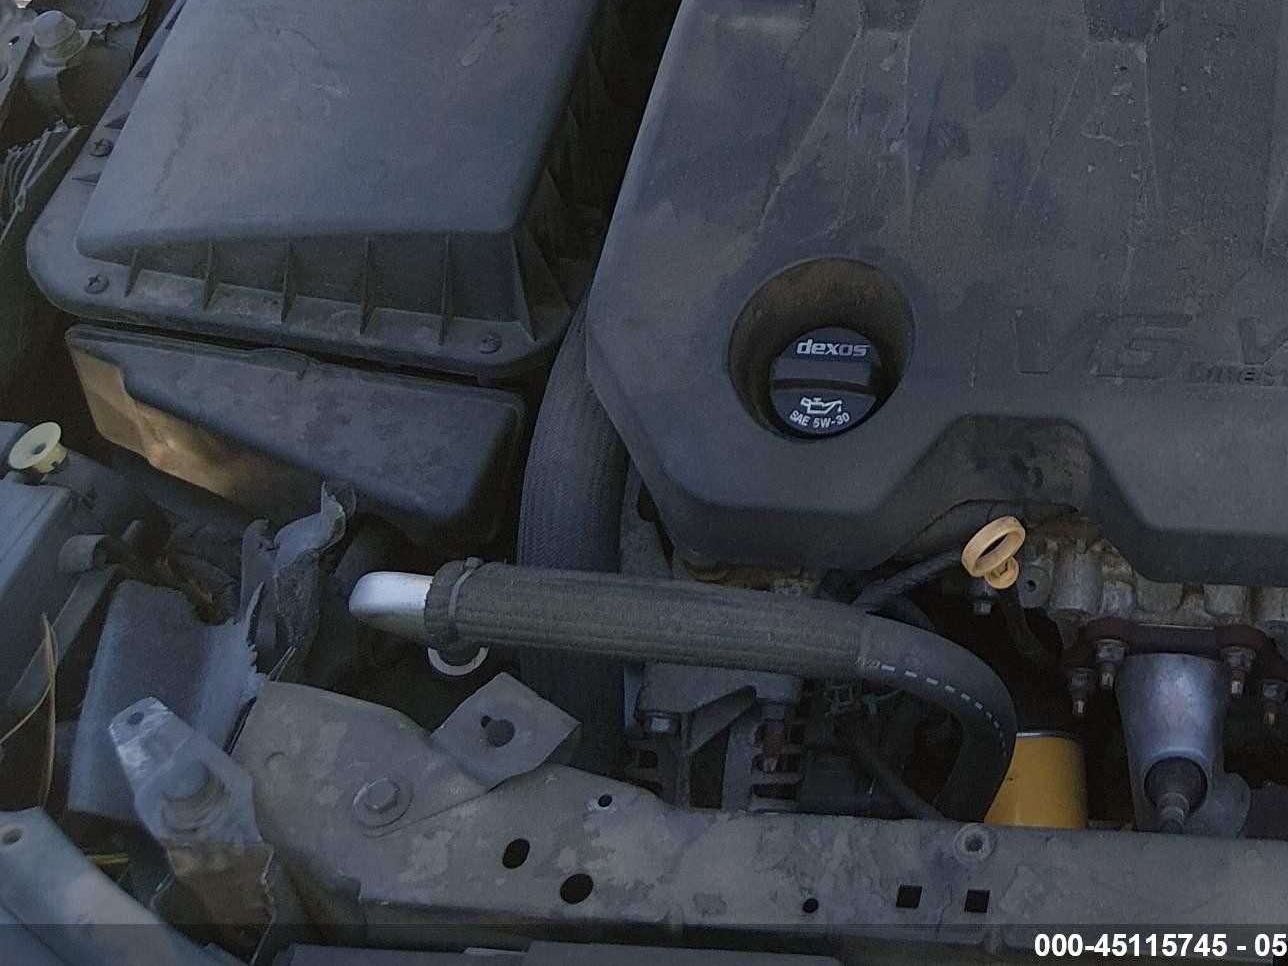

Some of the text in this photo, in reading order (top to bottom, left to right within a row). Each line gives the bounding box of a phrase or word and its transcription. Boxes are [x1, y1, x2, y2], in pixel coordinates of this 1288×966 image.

[796, 339, 869, 356] dexos
[789, 410, 850, 428] SAE 5W-30
